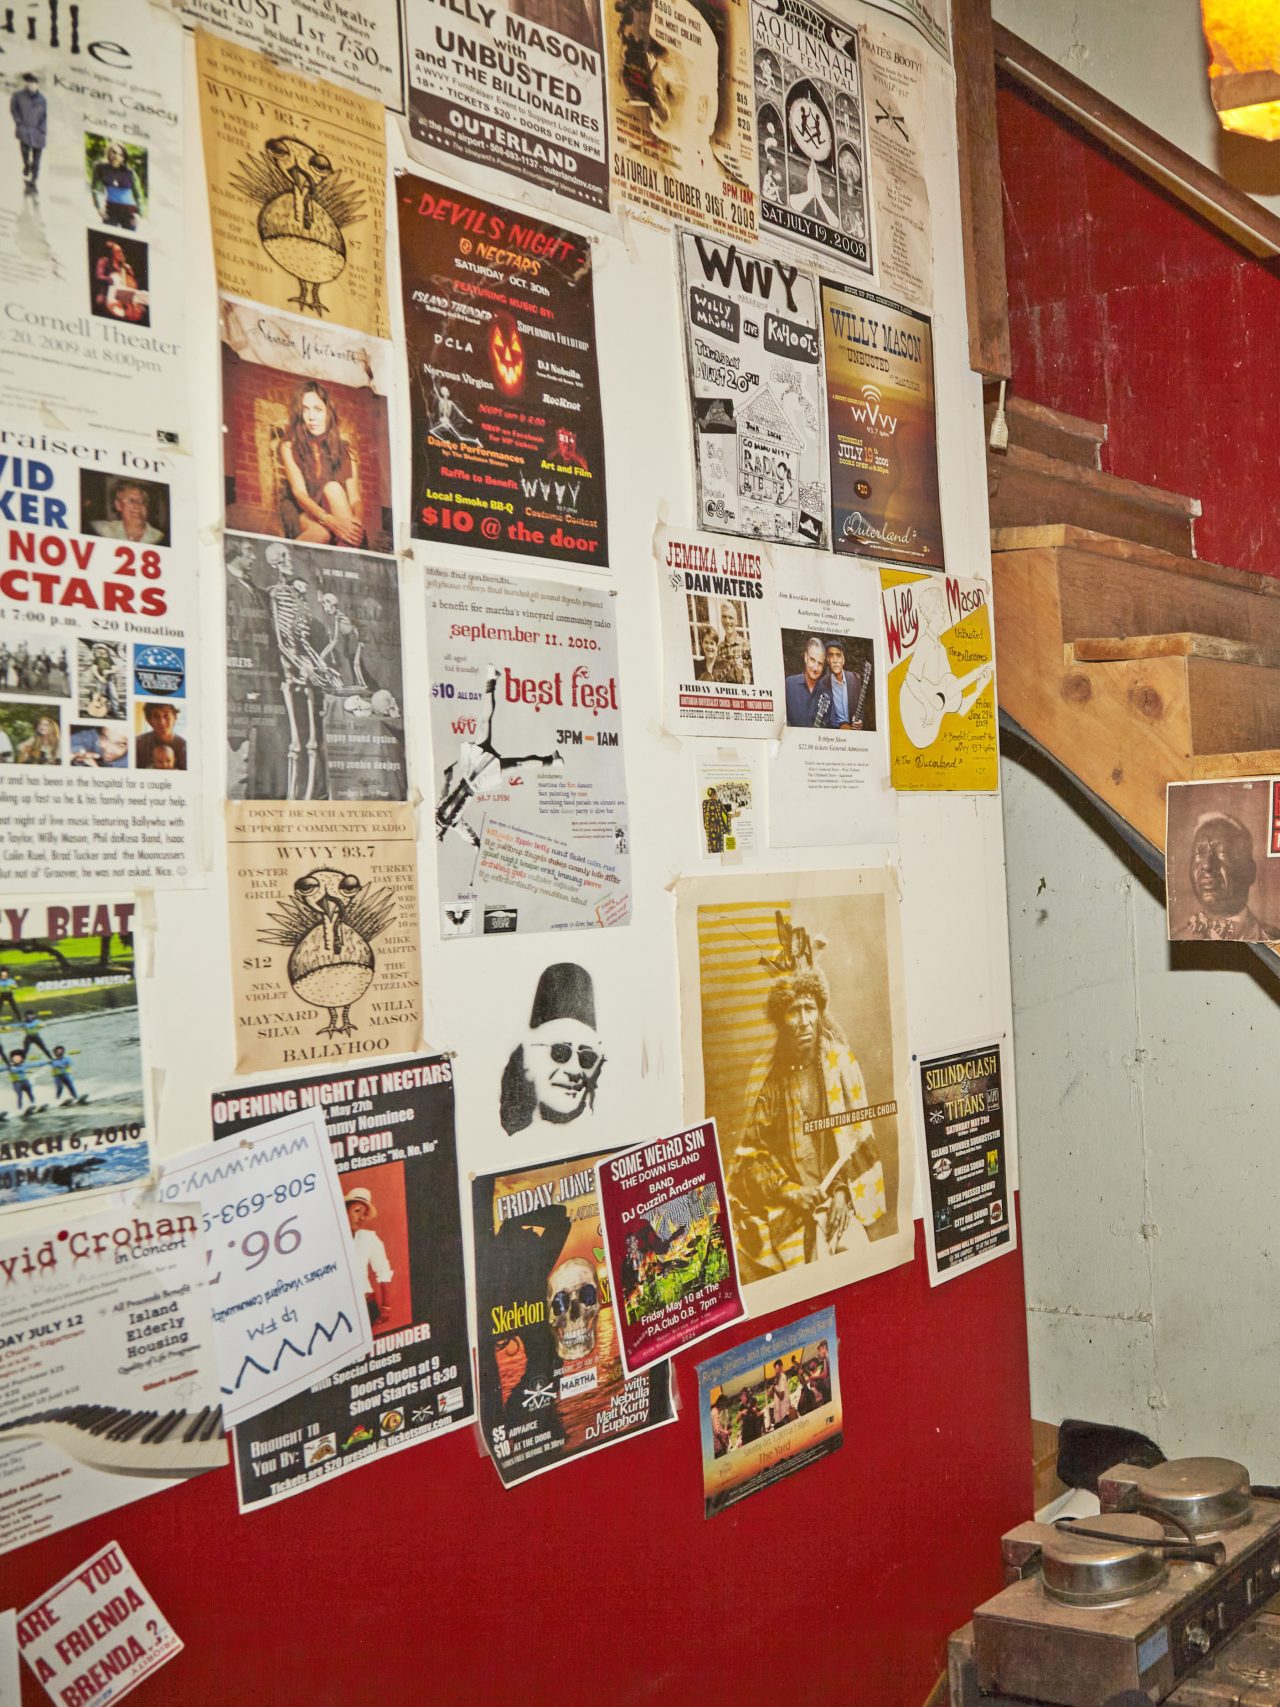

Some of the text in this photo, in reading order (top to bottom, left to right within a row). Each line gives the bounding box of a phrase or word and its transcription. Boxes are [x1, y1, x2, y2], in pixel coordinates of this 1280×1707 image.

[494, 37, 527, 61] with
[506, 15, 596, 75] MASON
[756, 11, 854, 77] AQUINNAH
[435, 25, 582, 106] UNBUSTED
[756, 30, 793, 58] MUSIC
[800, 55, 854, 92] FESTIVAL
[54, 74, 113, 103] Karan
[120, 96, 178, 127] Casey
[415, 48, 599, 132] and THE BILLIONAIRES
[453, 77, 494, 102] Fundraiser
[447, 86, 580, 149] TICKETS DOORS OPEN
[449, 109, 577, 173] OUTERLAND
[664, 173, 701, 209] OCTOBER
[418, 193, 574, 260] DEVILS NIGHT
[454, 258, 504, 281] SATURDAY
[476, 242, 541, 276] NECTARS
[695, 236, 798, 313] WVVY
[5, 302, 180, 356] Cornell Theater
[744, 320, 759, 338] LIVE
[829, 308, 922, 363] WILLY MASON
[847, 347, 890, 374] UNBUSTED
[423, 363, 494, 390] Nervous Virgins
[121, 449, 166, 474] for
[460, 442, 525, 464] Performances
[838, 443, 863, 462] JULY
[441, 466, 470, 482] Raffle
[541, 460, 554, 471] Art
[426, 488, 488, 509] Local Smoke
[422, 506, 598, 552] $10 the door
[8, 529, 162, 580] NOV 28
[666, 541, 762, 580] JEMIMA JAMES
[685, 571, 763, 600] DAN WATERS
[439, 600, 468, 611] benefit
[125, 621, 185, 638] Donation
[522, 610, 592, 628] vineyard community
[882, 577, 985, 664] Willy Mason
[451, 623, 540, 643] september
[432, 683, 454, 699] $10
[504, 665, 618, 716] best fest
[680, 683, 711, 695] FRIDAY
[556, 730, 618, 746] 3PM 1AM
[235, 824, 406, 833] SUPPORT COMMUNITY RADIO
[342, 845, 375, 858] 93.7
[238, 868, 288, 877] OYSTER
[370, 864, 415, 873] TURKEY
[251, 879, 278, 888] BAR
[47, 903, 135, 941] BEAT
[242, 957, 272, 970] $12
[239, 1009, 319, 1027] MAYNARD
[371, 999, 416, 1012] WILLY
[369, 1011, 419, 1027] MASON
[257, 1026, 301, 1039] SILVA
[282, 1038, 390, 1063] BALLYHOO
[213, 1062, 452, 1124] OPENING NIGHT AT NECTARS
[330, 1100, 373, 1120] May 27th
[358, 1108, 415, 1130] Nominee
[946, 1093, 985, 1121] TITANS
[94, 1122, 141, 1146] 2010
[804, 1112, 851, 1133] RETRIBUTION
[946, 1123, 969, 1135] SATURDAY
[347, 1131, 393, 1156] Penn
[611, 1128, 706, 1181] SOME WEIRD SIN
[931, 1146, 949, 1158] ISLAND
[351, 1152, 387, 1170] Classic
[621, 1152, 699, 1190] THE DOWN ISLAND
[497, 1168, 595, 1221] FRIDAY JUNE
[621, 1173, 706, 1224] DJ Cuzzin Andrew
[649, 1177, 674, 1195] BAND
[132, 1238, 187, 1260] Concert
[129, 1302, 178, 1324] Island
[492, 1301, 544, 1335] Skeleton
[641, 1309, 665, 1326] Friday
[29, 1315, 83, 1339] JULY 12
[126, 1316, 185, 1342] Elderly
[127, 1332, 189, 1358] Housing
[371, 1323, 431, 1357] THUNDER
[369, 1352, 401, 1371] Guests
[350, 1365, 457, 1417] Show Starts 9:30
[351, 1366, 416, 1400] Doors Open
[561, 1373, 595, 1391] MARTHA
[611, 1387, 649, 1408] Nebulla
[620, 1398, 648, 1416] Kurth
[602, 1409, 648, 1436] Euphony
[17, 1550, 122, 1649] ARE YOU
[35, 1586, 144, 1684] A FRIENDA
